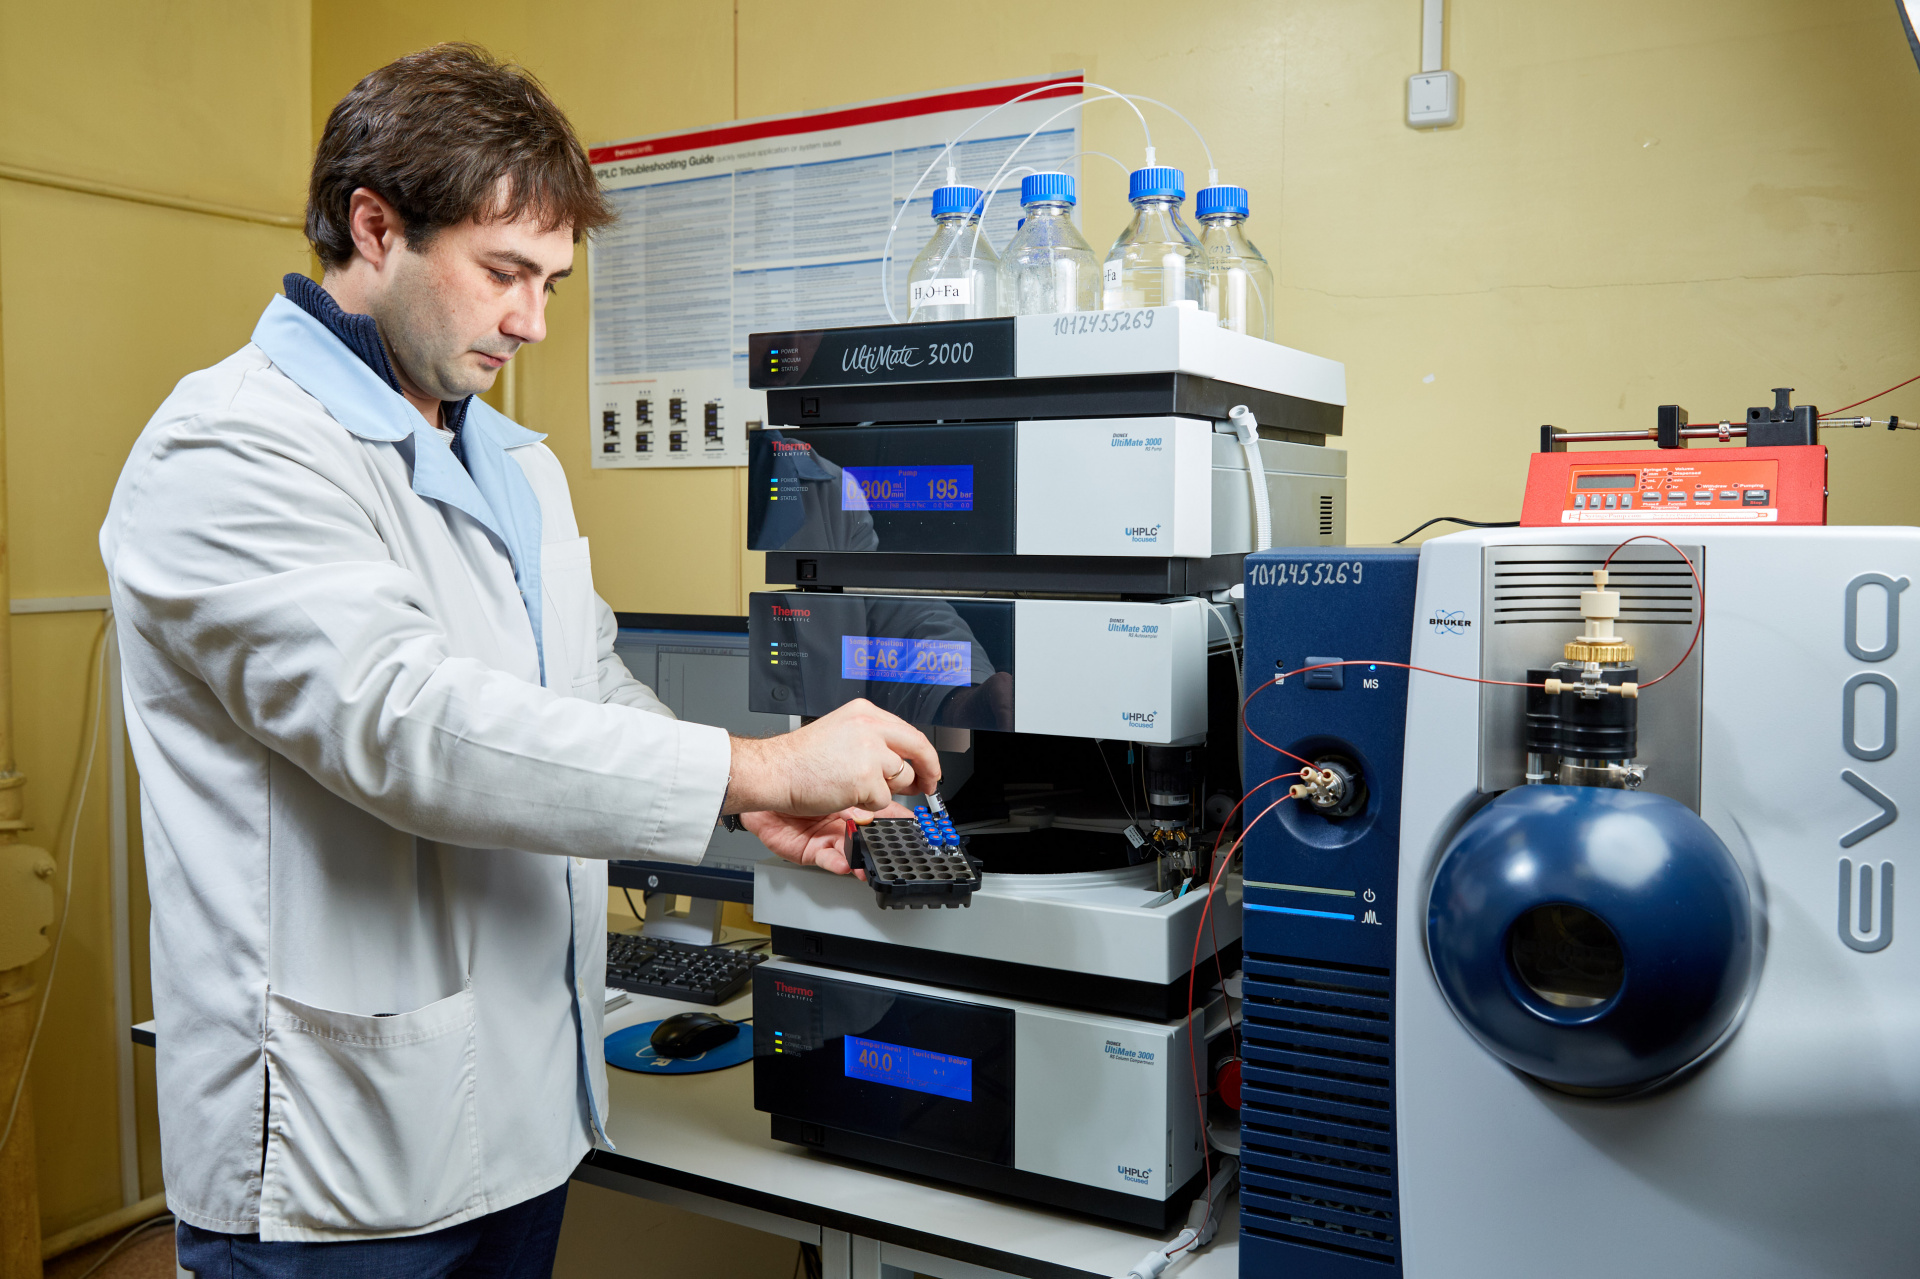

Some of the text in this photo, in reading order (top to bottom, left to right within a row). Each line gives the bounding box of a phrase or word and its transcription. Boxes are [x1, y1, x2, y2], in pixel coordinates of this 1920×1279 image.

[620, 159, 687, 176] Troubleshooting
[689, 154, 714, 166] Guide
[757, 146, 789, 157] application
[799, 142, 821, 152] system
[822, 140, 842, 148] issues
[915, 285, 959, 300] HO+Fa
[1053, 309, 1155, 335] 1012455269
[842, 342, 974, 374] UltiMate 3000
[772, 441, 811, 452] Thermo
[1111, 438, 1162, 447] UltiMate 3000
[846, 480, 891, 500] 0.300
[928, 479, 958, 499] 195
[1248, 562, 1363, 586] 1012455269
[771, 606, 811, 616] Thermo
[1108, 624, 1158, 633] UltiMate 3000
[1429, 618, 1471, 627] BRUKER
[876, 639, 903, 647] Position
[914, 641, 936, 649] Inject
[854, 648, 898, 669] G-A6
[916, 651, 962, 672] 20.00
[1363, 679, 1379, 689] MS
[1838, 572, 1910, 953] EVOQ
[774, 981, 814, 997] Thermo
[776, 992, 813, 1002] SCIENTIFIC
[856, 1039, 968, 1066] Compartment Switching Valve
[1104, 1045, 1154, 1060] UltiMate 3000
[859, 1049, 892, 1072] 40.0
[1124, 1174, 1148, 1185] focused
